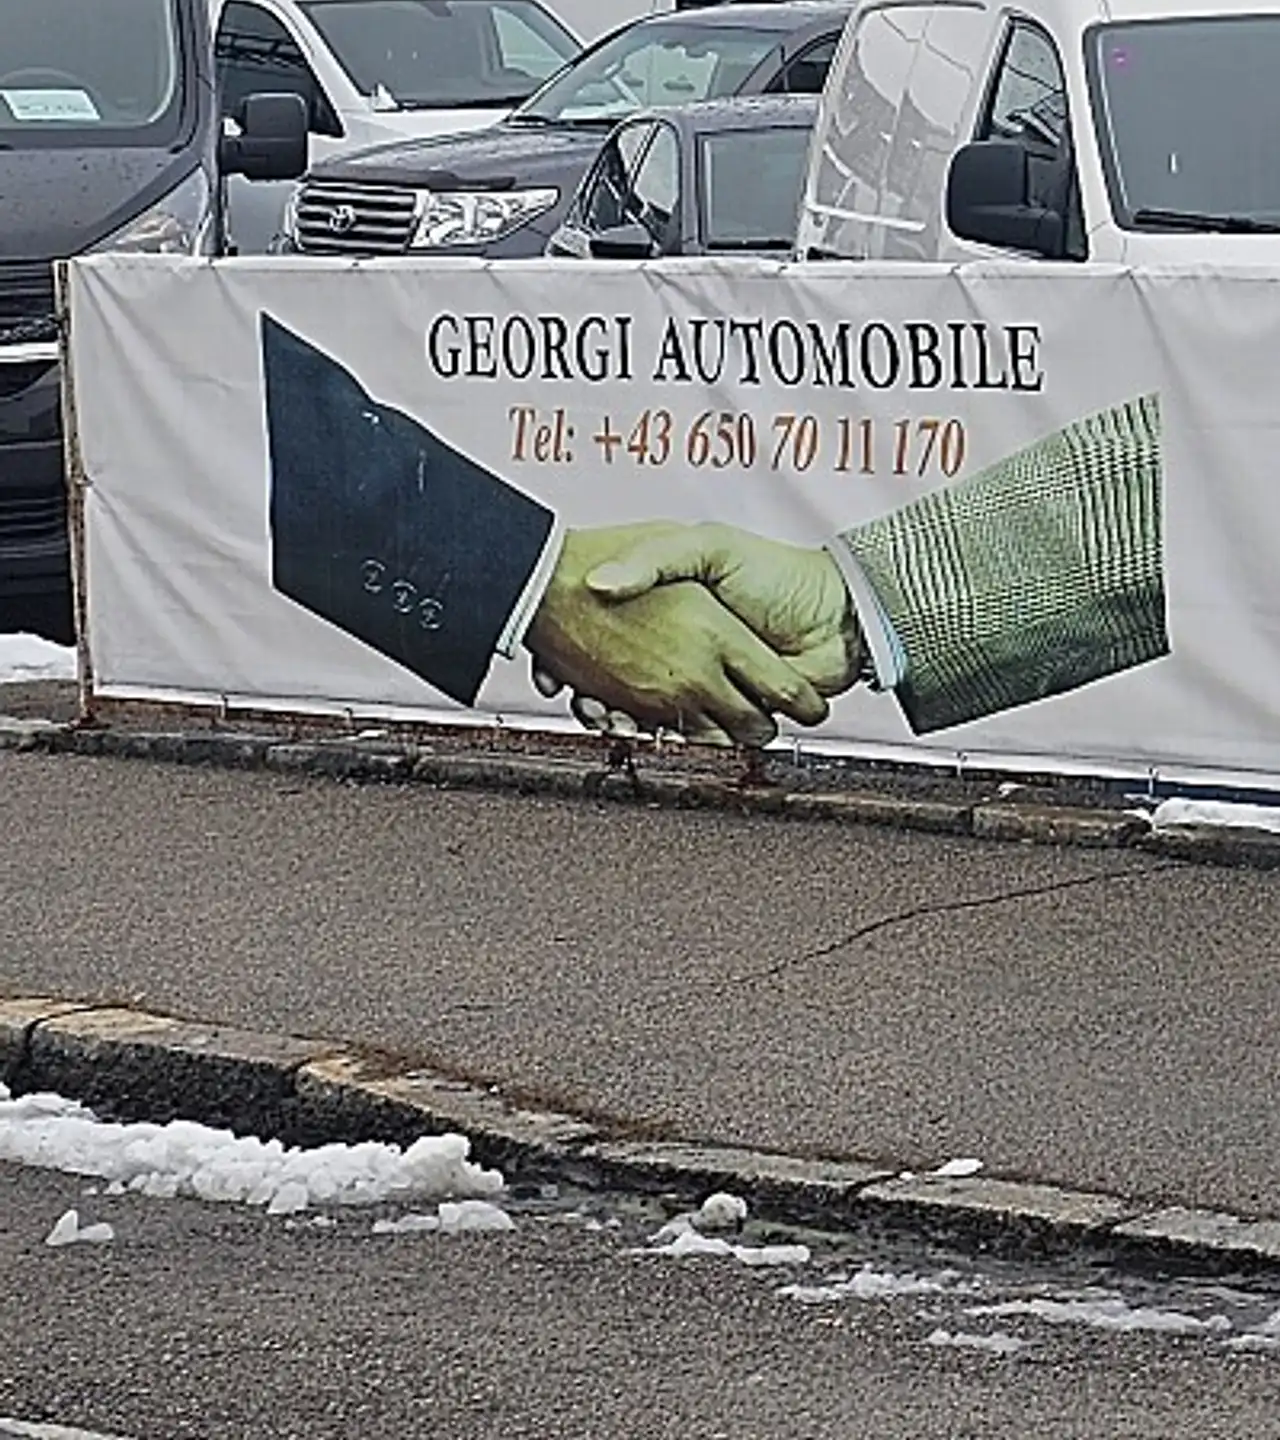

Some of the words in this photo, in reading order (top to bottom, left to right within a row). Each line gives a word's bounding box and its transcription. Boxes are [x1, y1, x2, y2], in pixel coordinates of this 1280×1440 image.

[427, 313, 633, 382] GEORGI
[652, 316, 1044, 392] AUTOMOBILE
[508, 406, 576, 463] Tel:
[593, 409, 674, 466] +43
[686, 411, 757, 469] 650
[770, 415, 819, 472] 70
[833, 417, 876, 474] 11
[892, 418, 966, 478] 170
